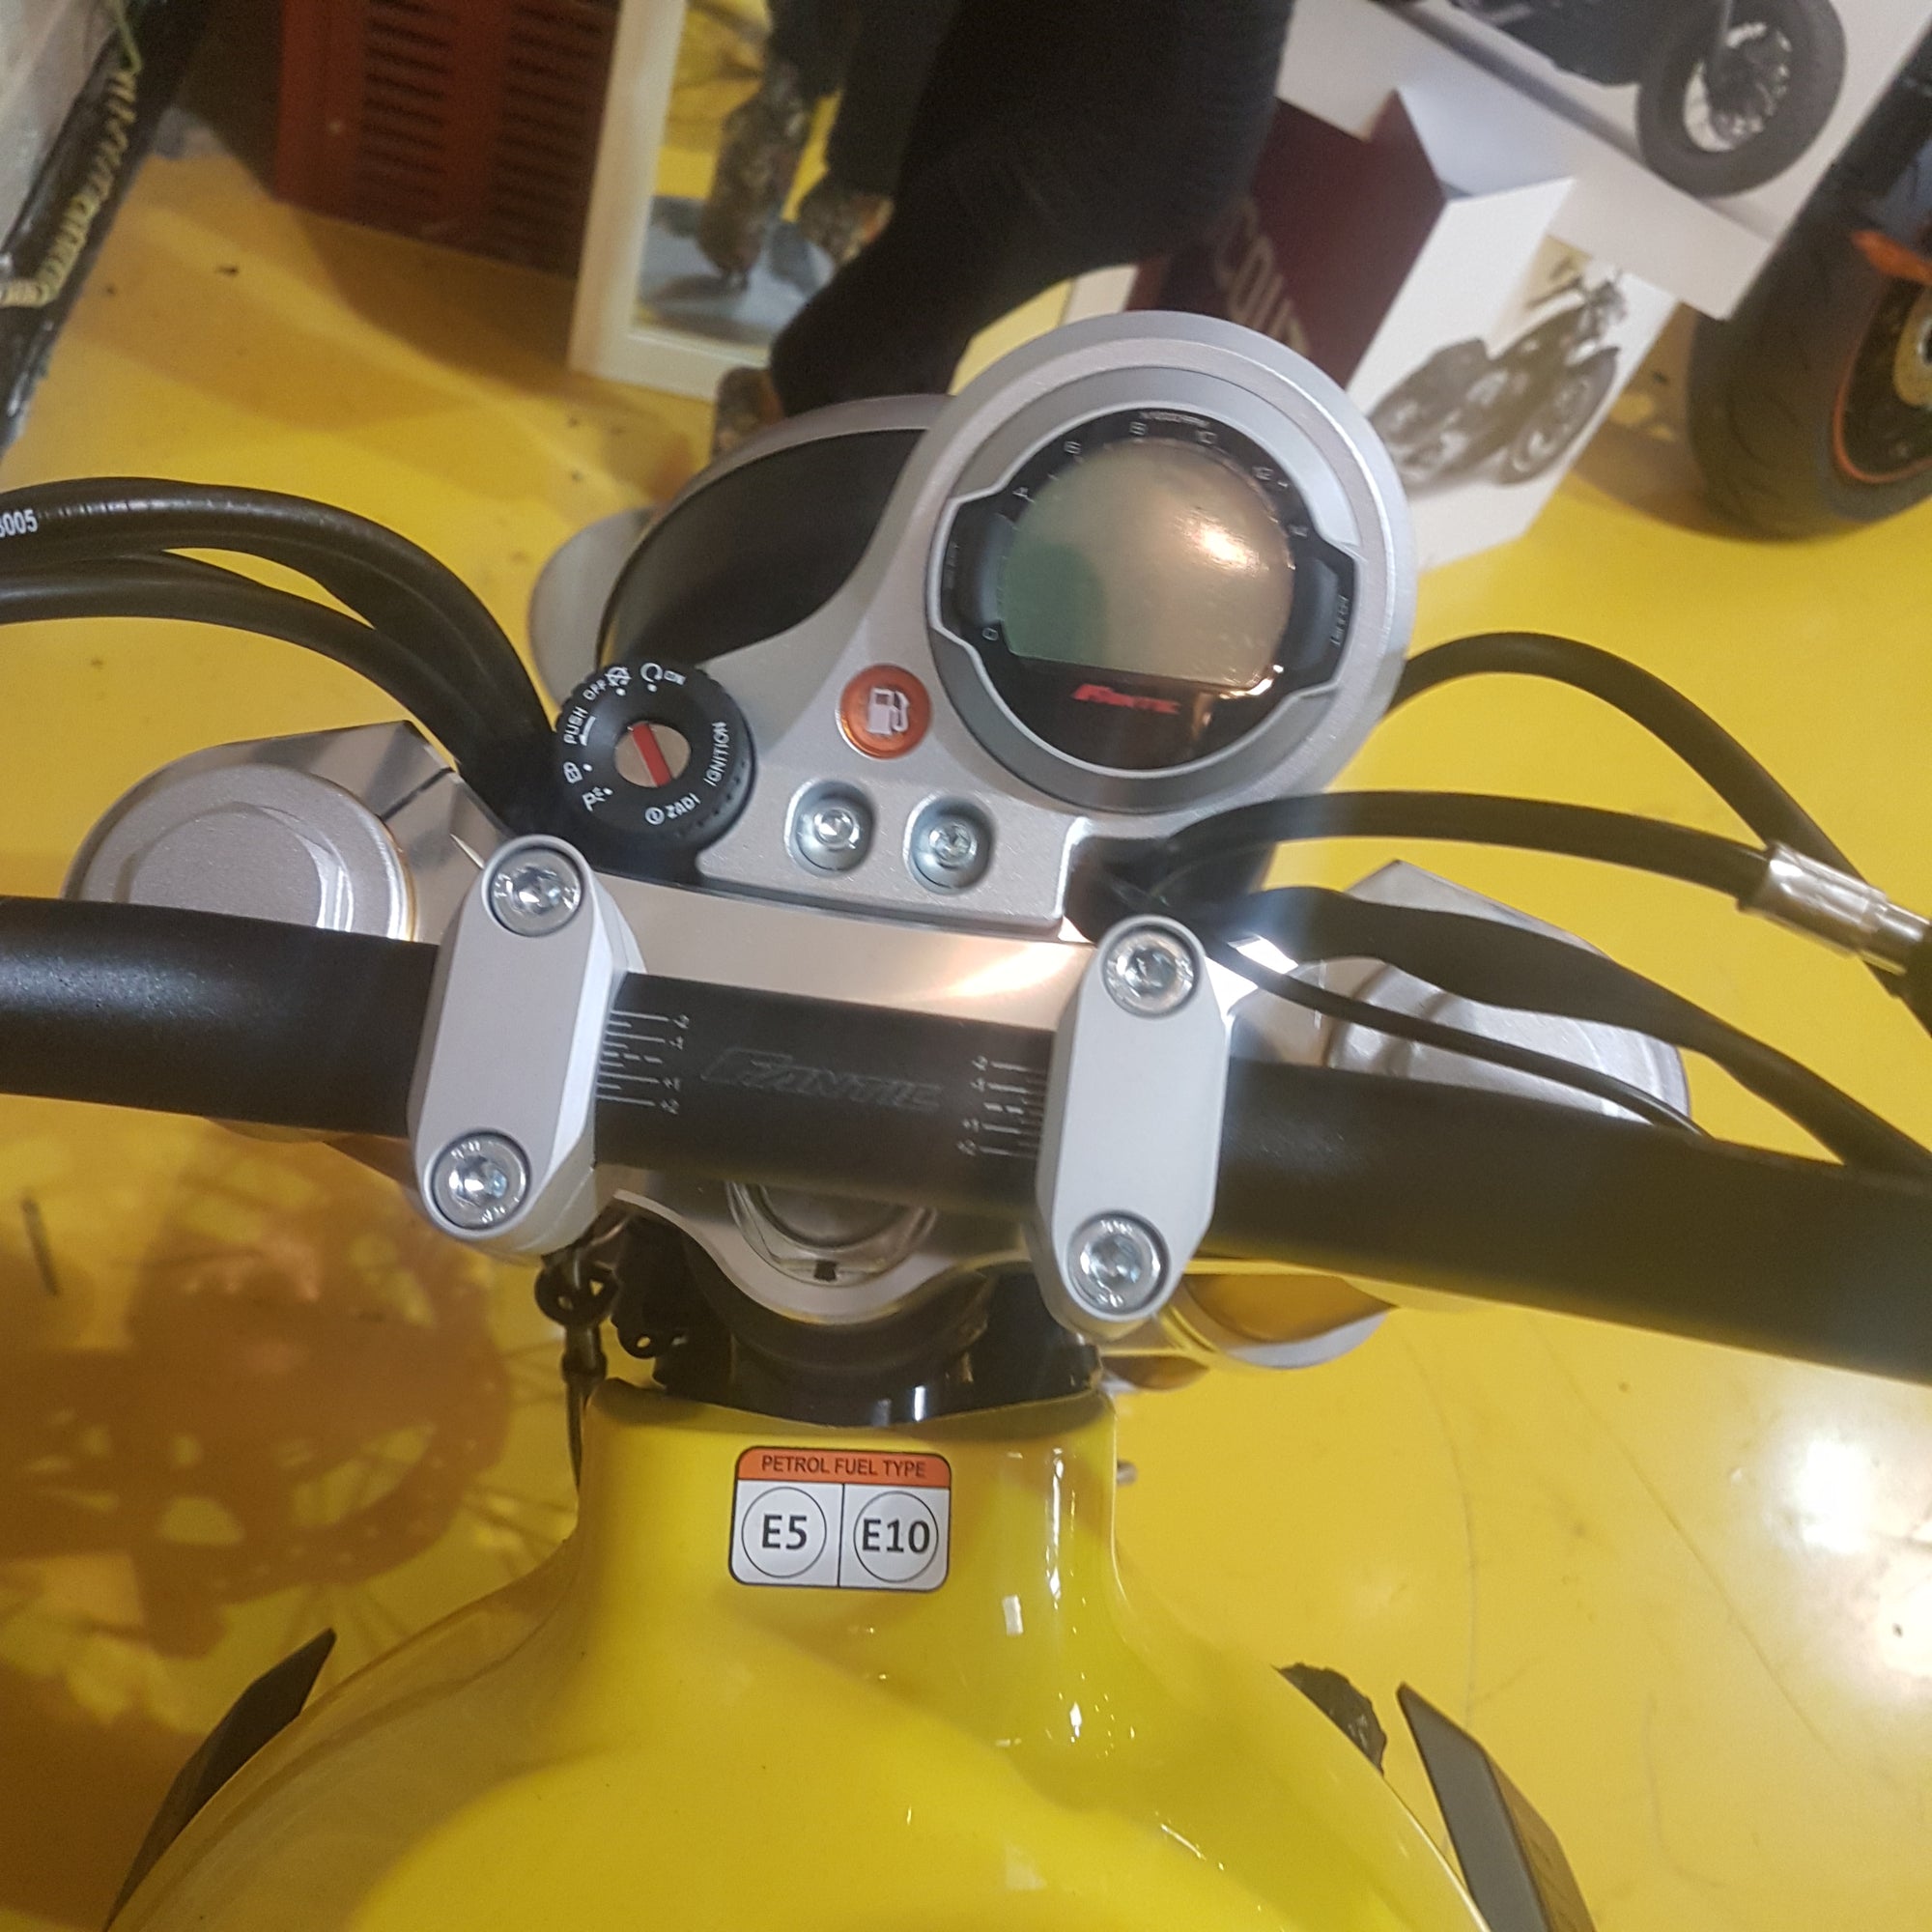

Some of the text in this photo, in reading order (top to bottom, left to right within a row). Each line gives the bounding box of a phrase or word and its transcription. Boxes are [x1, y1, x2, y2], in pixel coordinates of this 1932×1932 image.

[563, 706, 589, 745] PUSH
[703, 721, 730, 787] IGNITION
[665, 792, 701, 819] ZADI
[760, 1454, 926, 1479] PETROL FUEL TYPE
[761, 1513, 808, 1550] E5
[862, 1517, 931, 1554] E10
